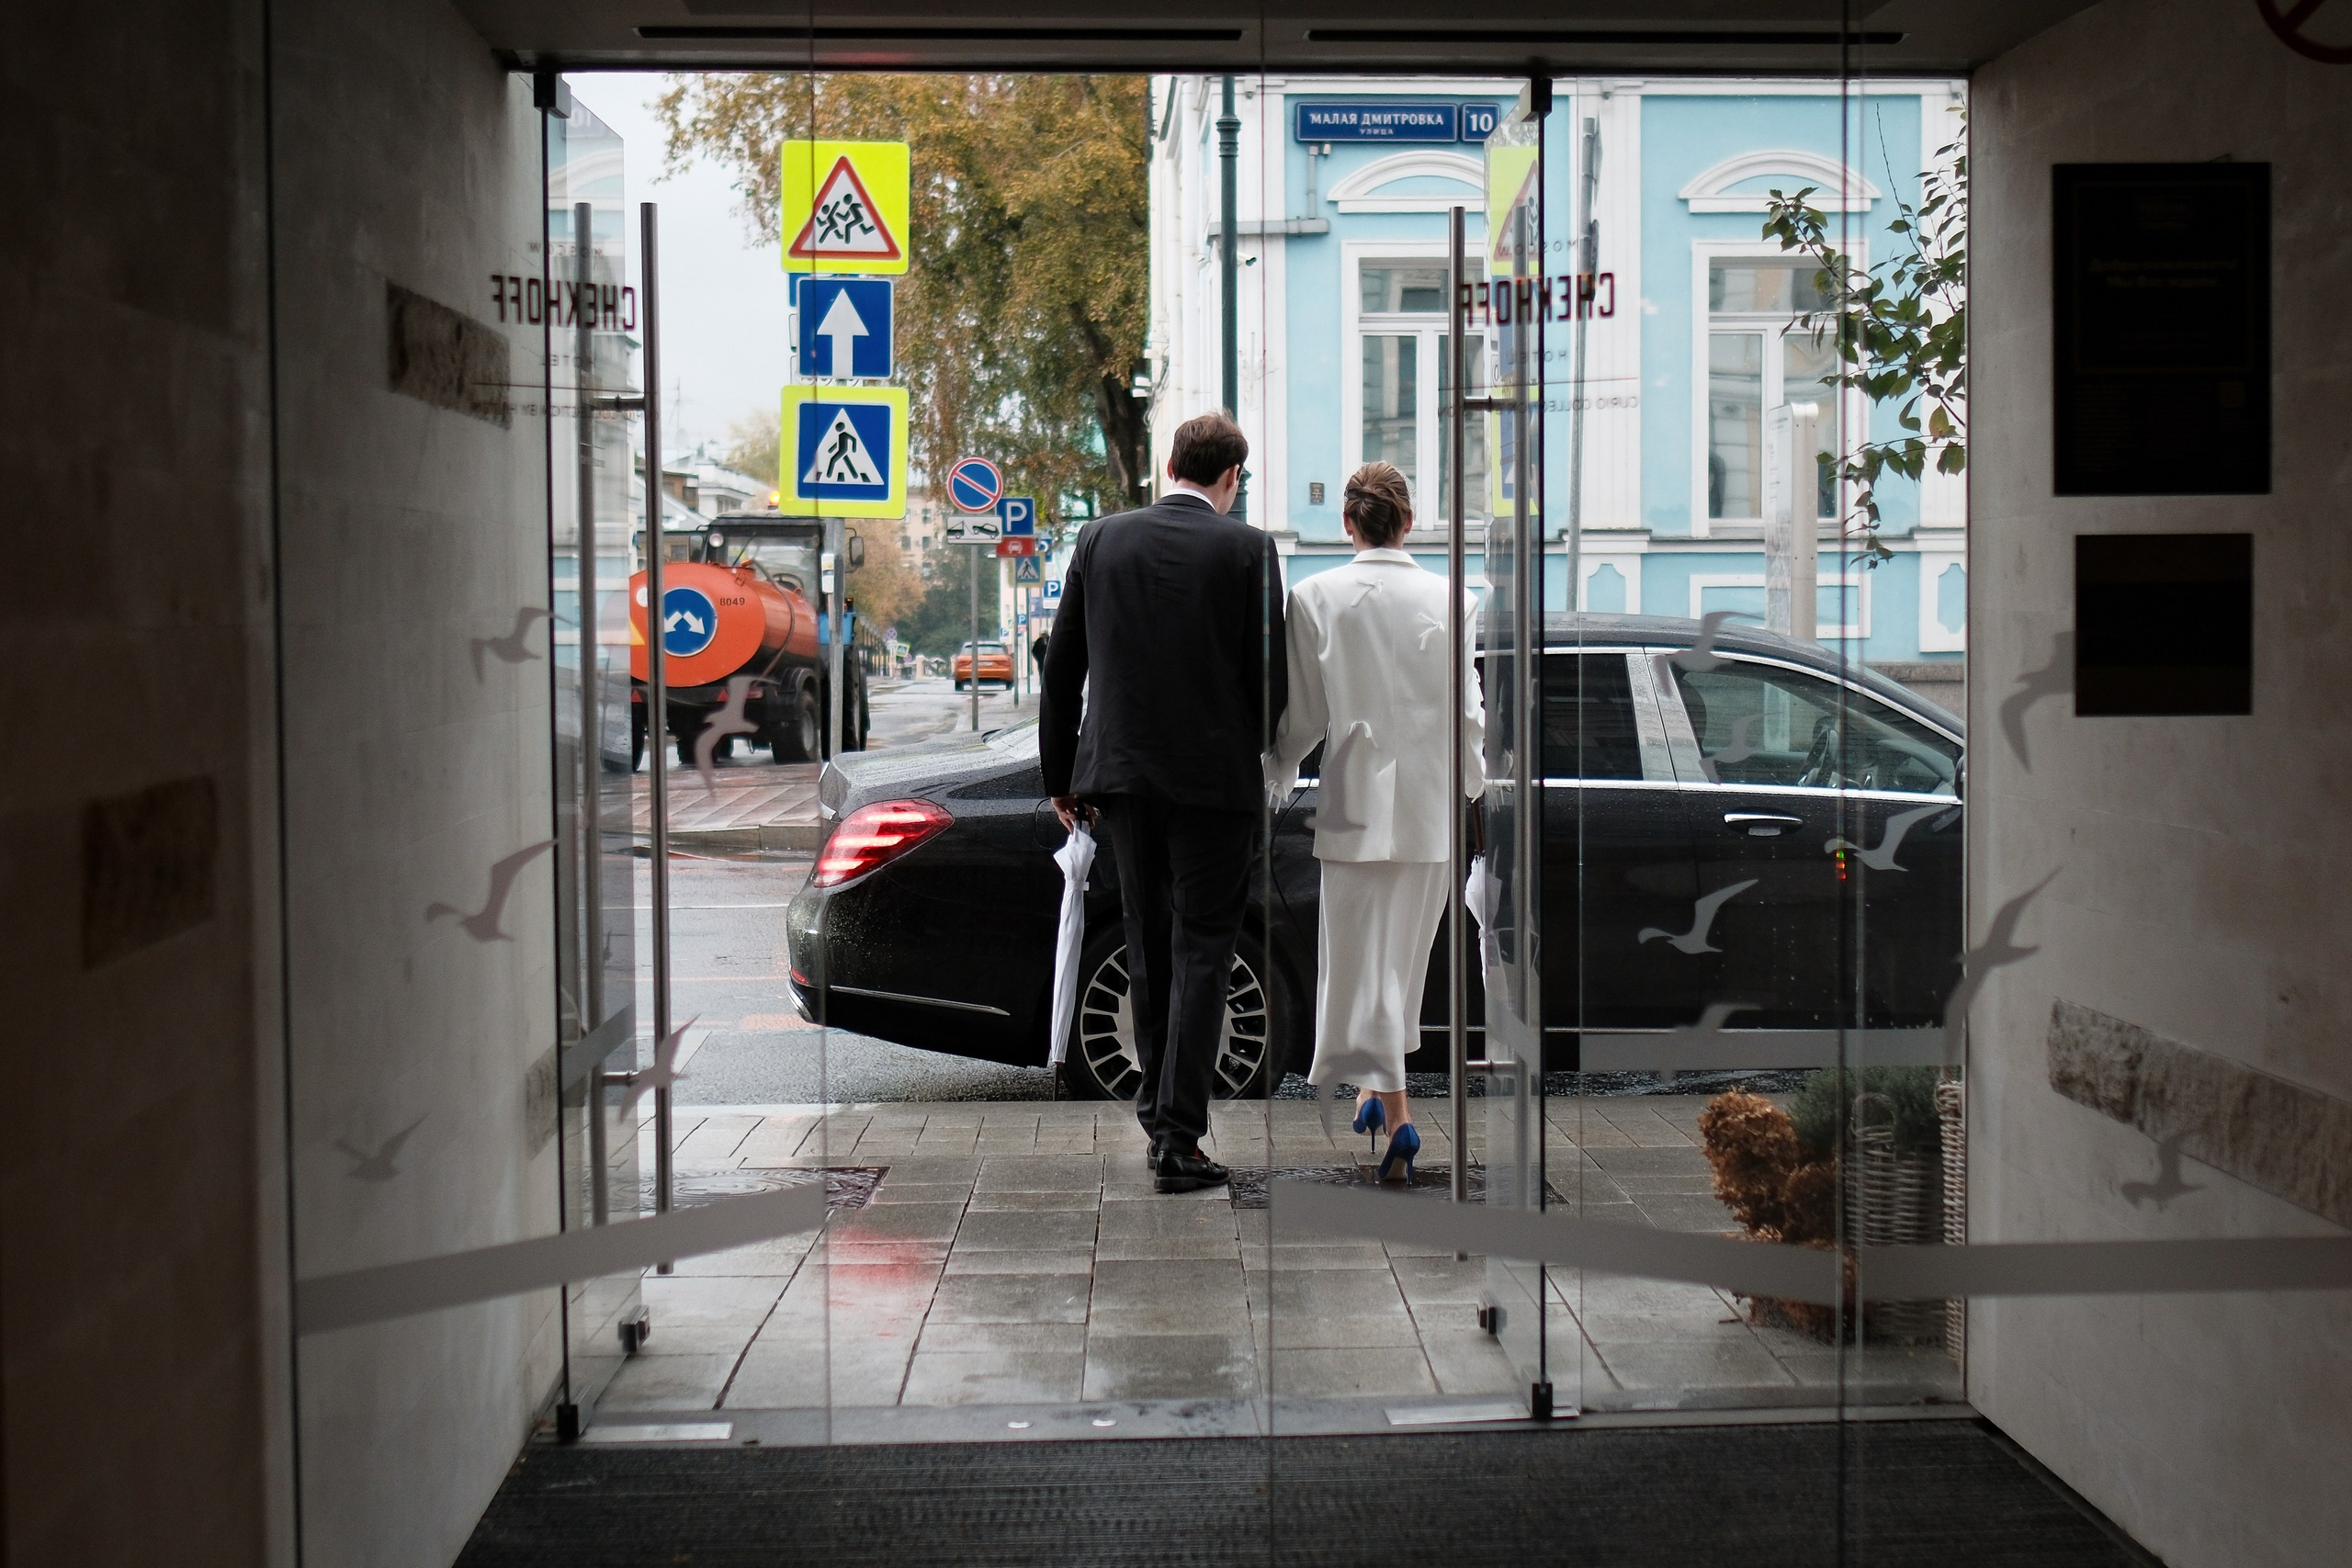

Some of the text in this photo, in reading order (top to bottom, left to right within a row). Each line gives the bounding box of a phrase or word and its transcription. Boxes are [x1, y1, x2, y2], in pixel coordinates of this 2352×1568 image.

[1310, 113, 1444, 126] МАЛАЯ ДМИТРОВКА
[1470, 113, 1493, 132] 10
[1006, 502, 1027, 533] P
[1047, 581, 1059, 597] P
